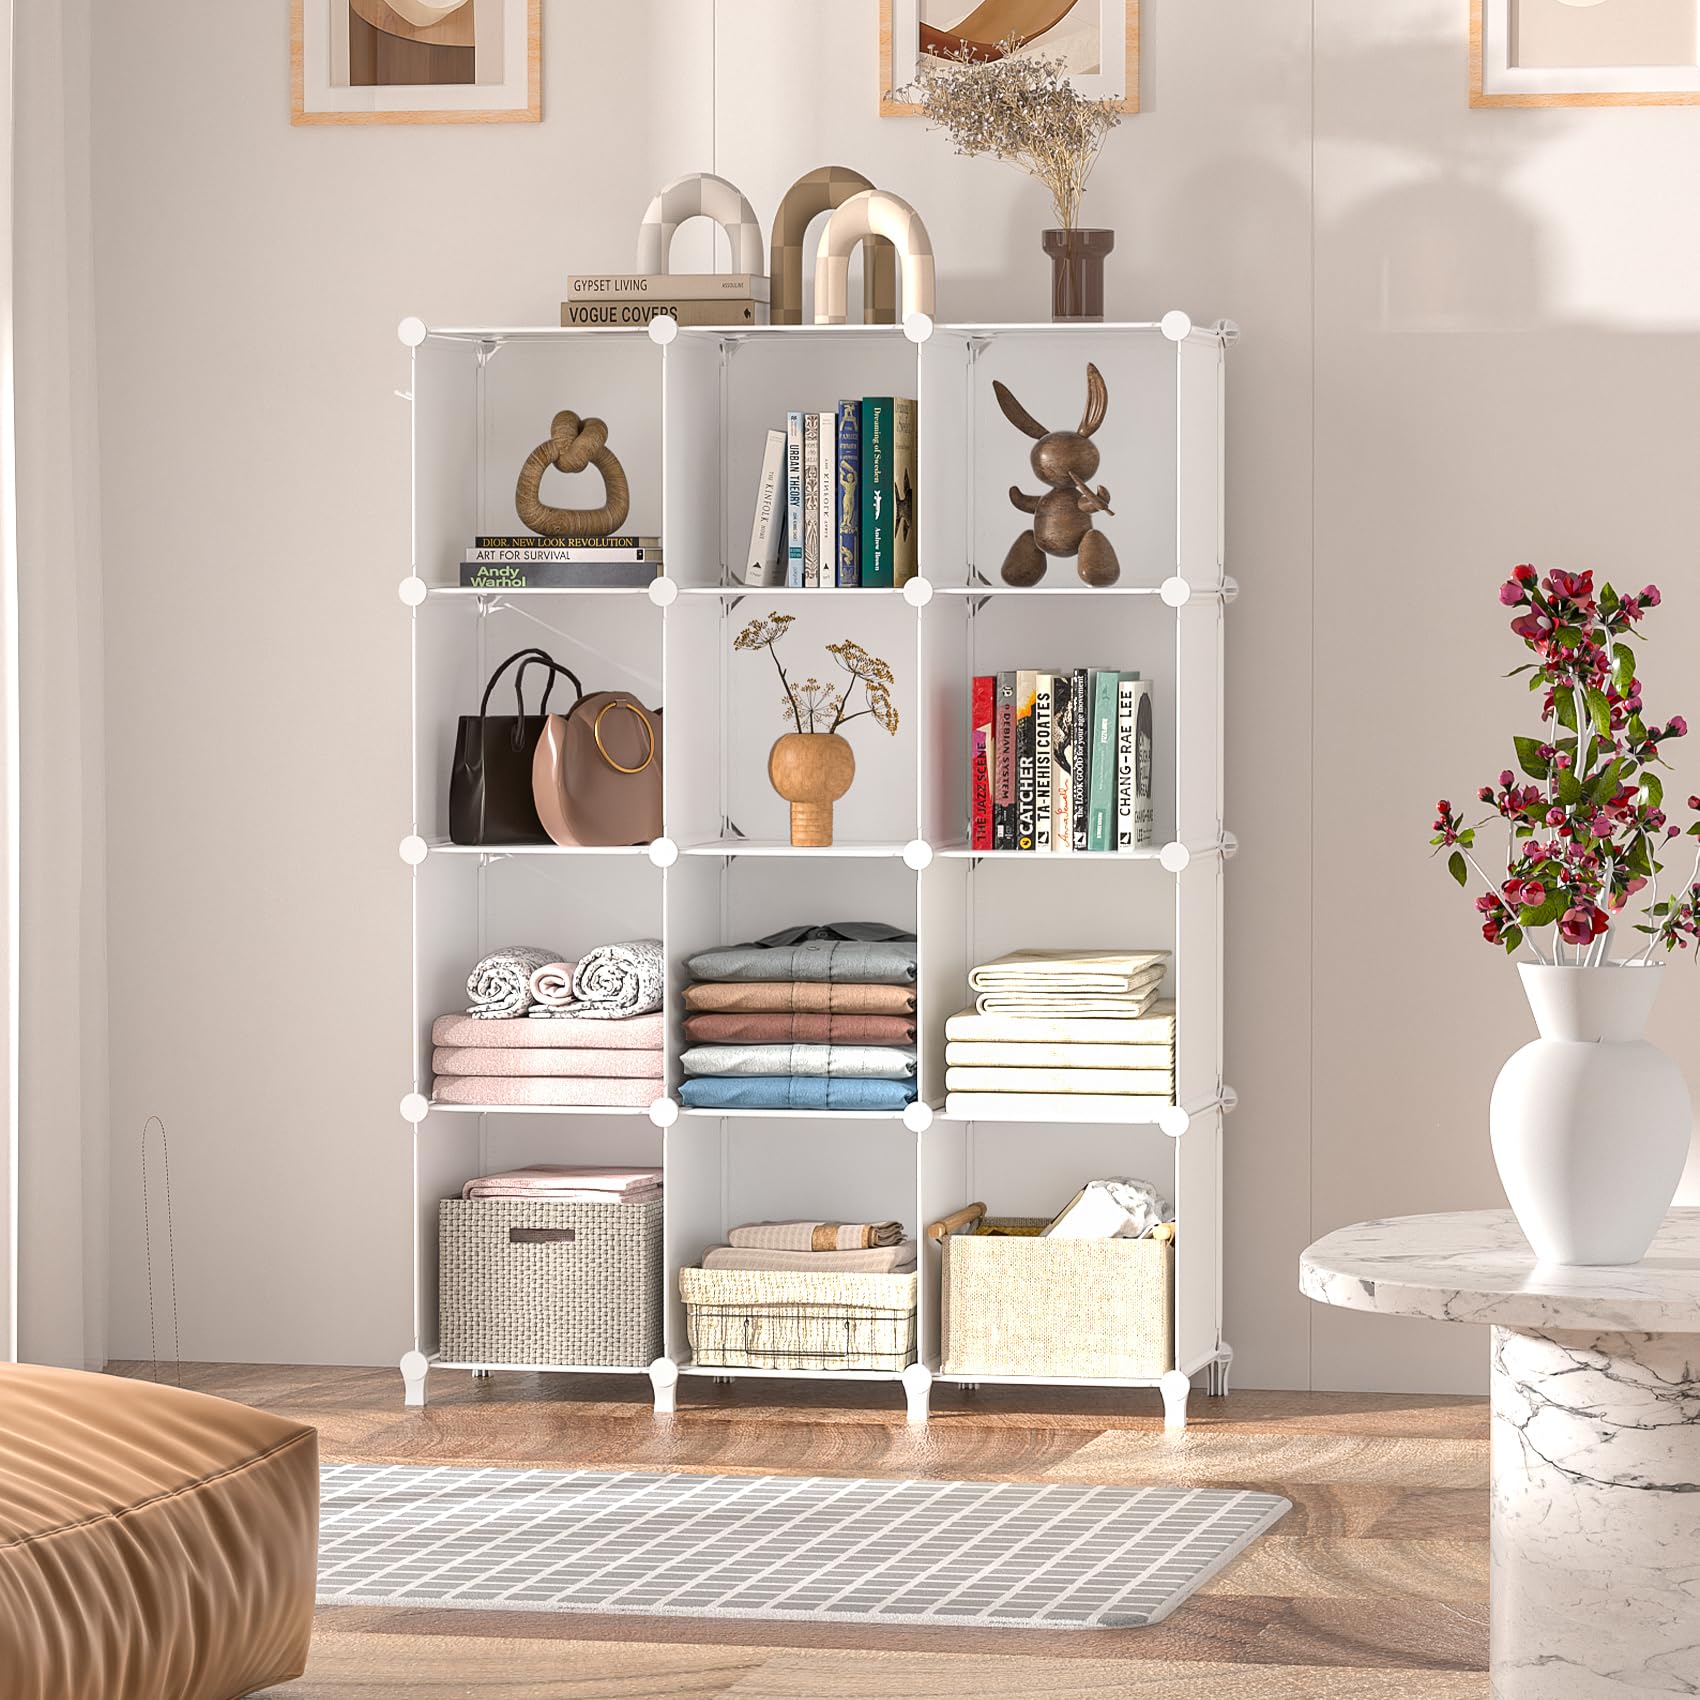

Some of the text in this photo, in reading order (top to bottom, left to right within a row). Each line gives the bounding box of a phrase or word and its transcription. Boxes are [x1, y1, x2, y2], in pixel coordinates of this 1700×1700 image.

[574, 279, 648, 291] GYPSET LIVING
[569, 306, 617, 322] VOGUE
[872, 407, 881, 444] Dreaming
[789, 444, 799, 472] URBAN
[874, 445, 881, 453] of
[760, 483, 774, 522] KINFOLK
[789, 476, 800, 507] THEORY
[476, 550, 571, 560] ART FOR SURVIVAL
[512, 538, 535, 547] NEW
[538, 538, 566, 547] LOOK
[568, 538, 633, 547] REVOLUTION
[470, 576, 526, 587] Warhol
[477, 565, 520, 579] Andy
[1003, 713, 1011, 753] DEBIAN
[1037, 693, 1050, 822] TA-NEHISI COATES
[1120, 691, 1132, 816] CHANG-RAE LEE
[1076, 757, 1084, 782] GOOD
[977, 742, 986, 842] THE JAZZ SCENE
[1020, 756, 1034, 835] CATCHER
[1075, 783, 1084, 805] LOOK
